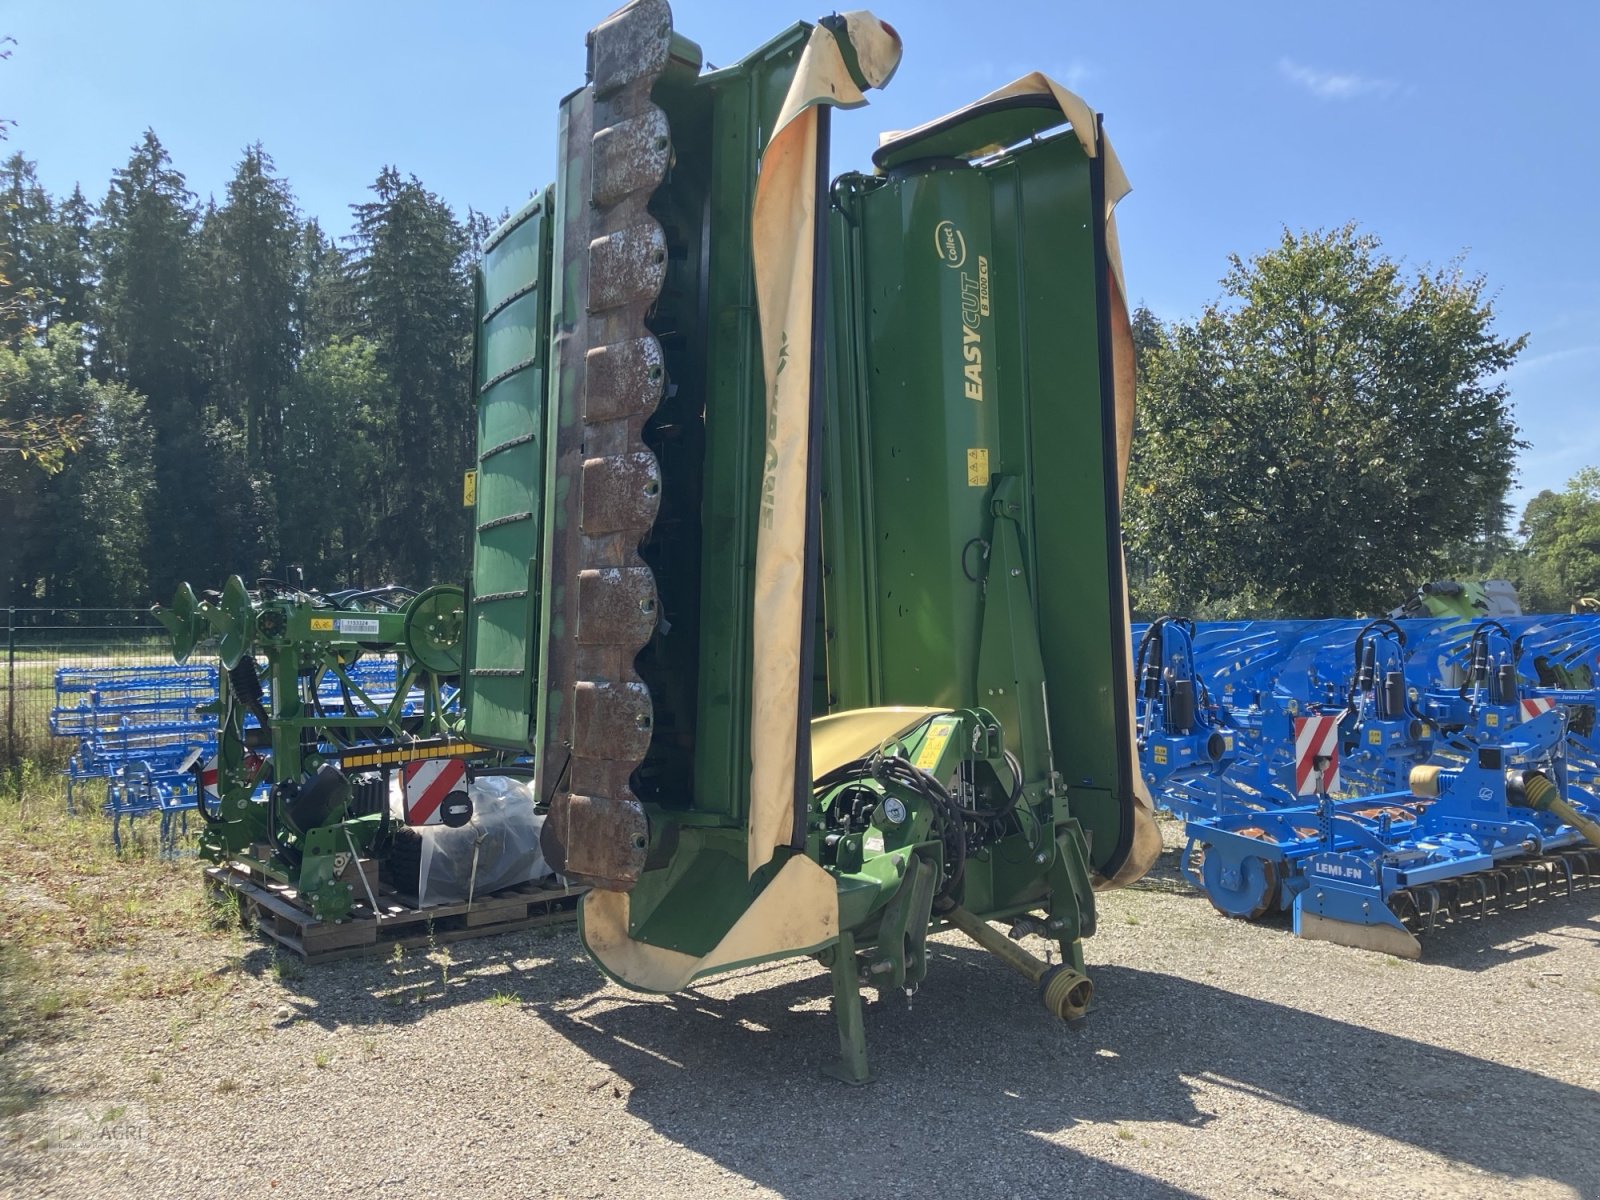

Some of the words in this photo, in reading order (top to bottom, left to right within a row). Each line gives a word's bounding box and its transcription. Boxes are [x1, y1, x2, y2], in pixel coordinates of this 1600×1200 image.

[945, 228, 957, 261] Collect
[980, 260, 988, 275] CV
[980, 276, 988, 301] 1000
[981, 303, 988, 312] B
[961, 271, 983, 402] EASYCUT
